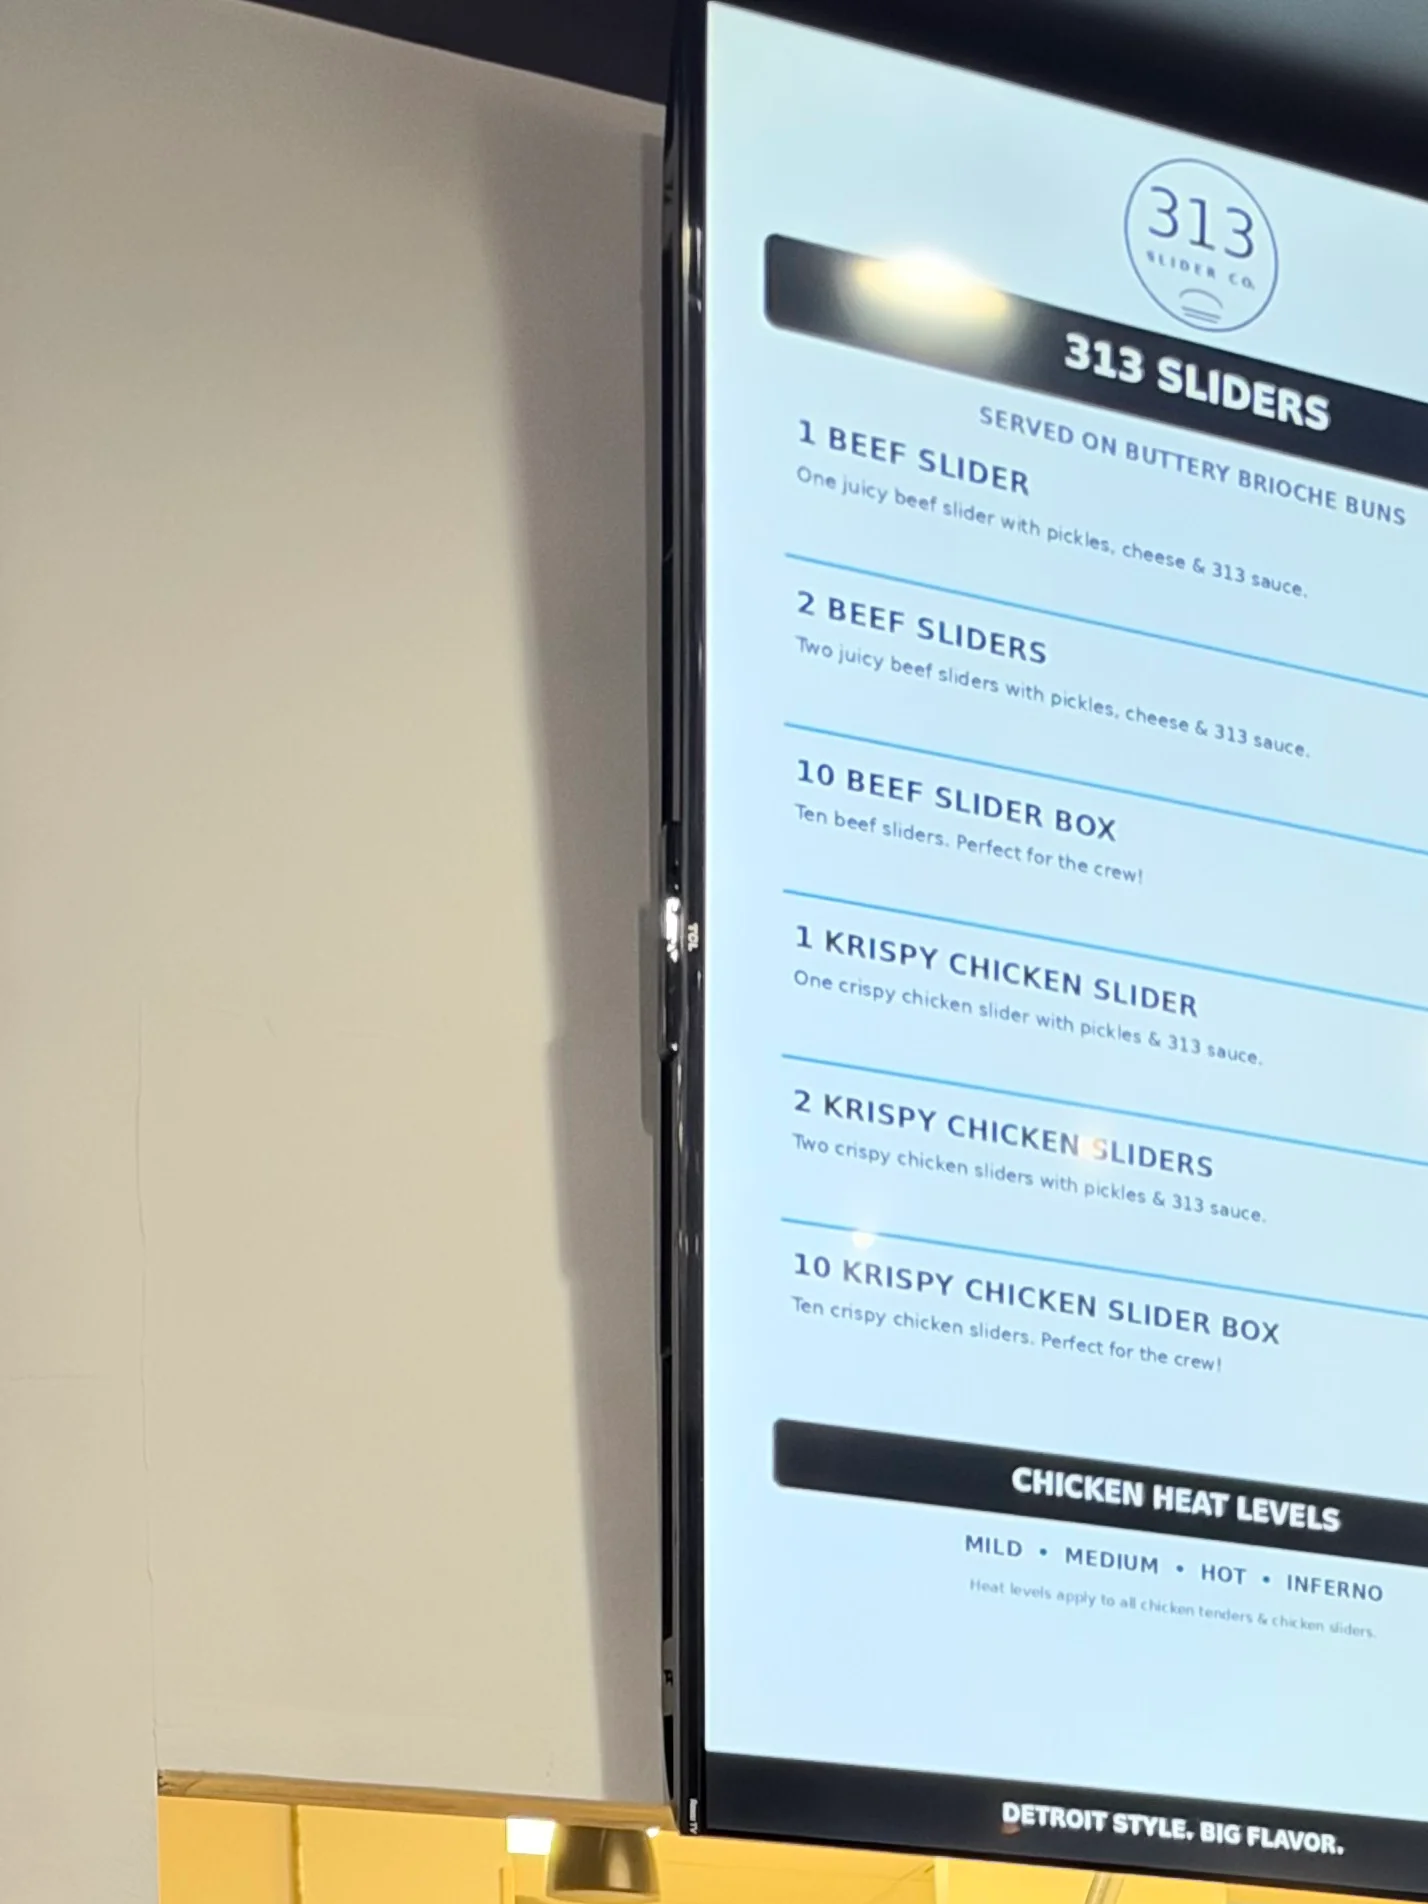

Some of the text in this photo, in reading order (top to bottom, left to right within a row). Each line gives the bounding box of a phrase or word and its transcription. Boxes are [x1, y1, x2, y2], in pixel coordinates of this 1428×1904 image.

[1149, 186, 1253, 259] 313
[1065, 332, 1329, 431] 313 SLIDERS
[800, 420, 1028, 495] 1 BEEF SLIDER
[980, 406, 1405, 525] SERVED ON BUTTERY BRIOCHE BUNS
[796, 465, 1306, 597] One juicy beef slider with pickles, cheese & 313 sauce.
[799, 591, 1046, 664] 2 BEEF SLIDERS
[798, 759, 1115, 841] 10 BEEF SLIDER BOX
[795, 1253, 1278, 1344] 10 KRISPY CHICKEN SLIDER BOX
[1012, 1466, 1341, 1532] CHICKEN HEAT LEVELS
[965, 1535, 1382, 1601] MILD MEDIUM HOT INFERNO
[1002, 1801, 1344, 1855] DETROIT STYLE. BIG FLAVOR.
